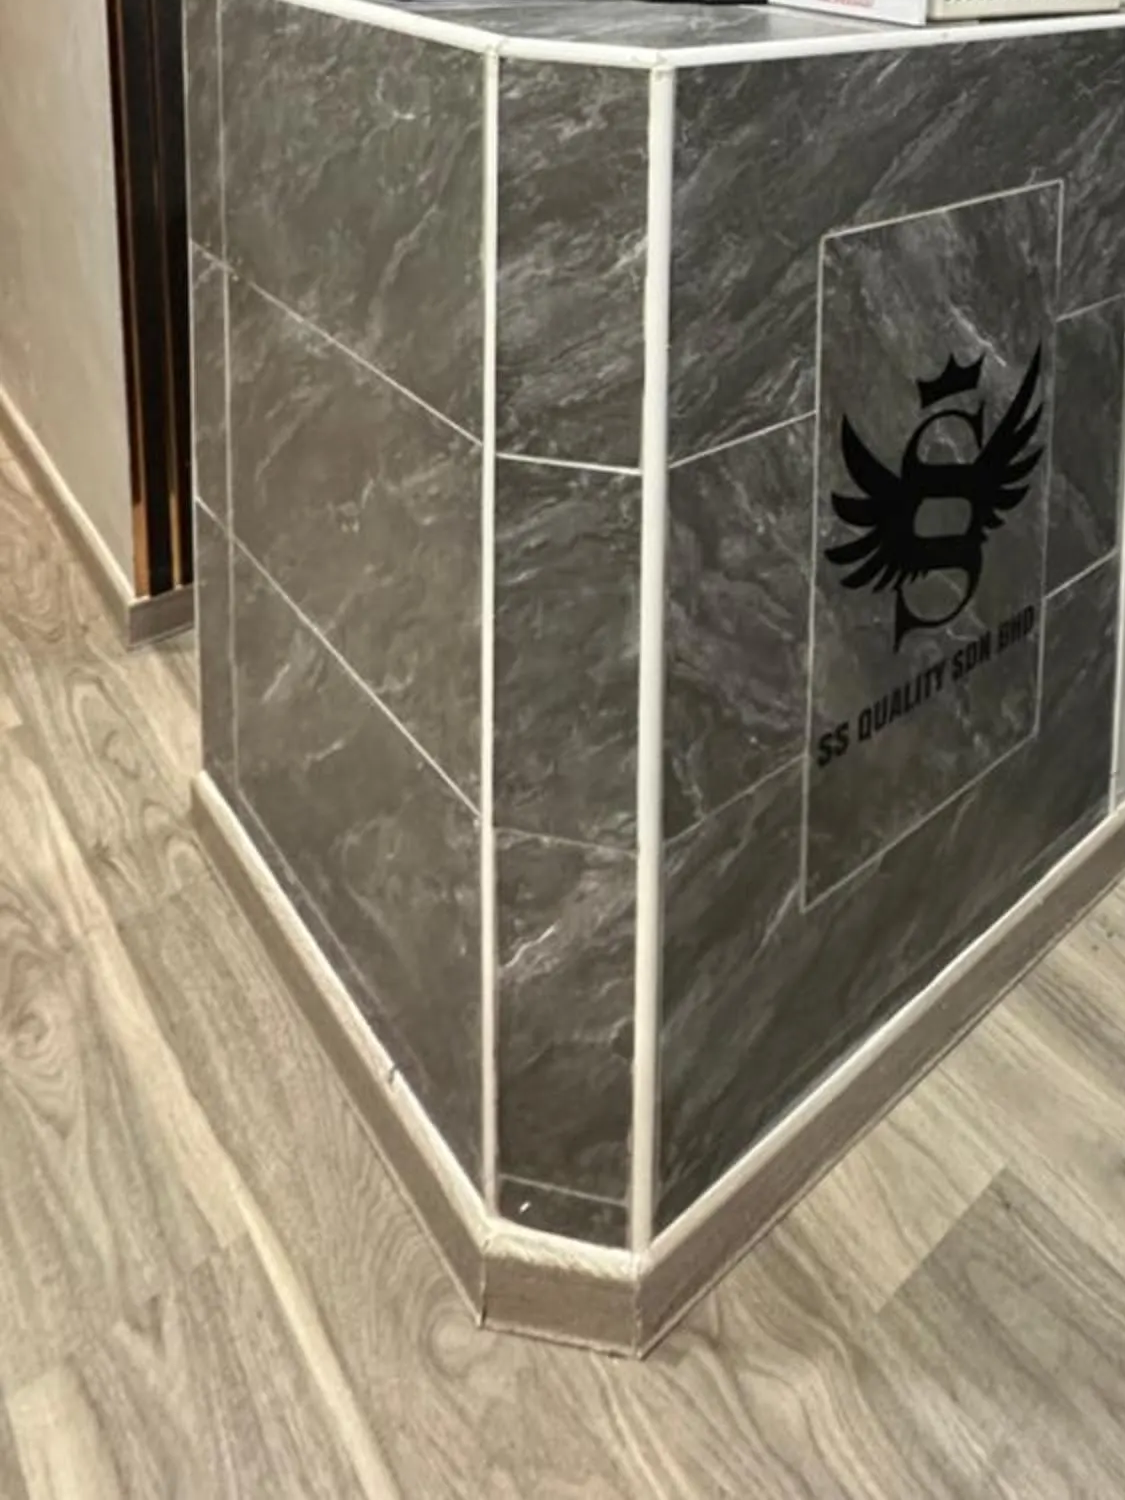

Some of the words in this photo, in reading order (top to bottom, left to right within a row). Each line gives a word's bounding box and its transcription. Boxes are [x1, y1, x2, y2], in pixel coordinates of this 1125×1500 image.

[817, 721, 850, 768] SS
[858, 659, 946, 742] QUALITY
[952, 630, 992, 682] SDN
[998, 604, 1036, 655] BHD
